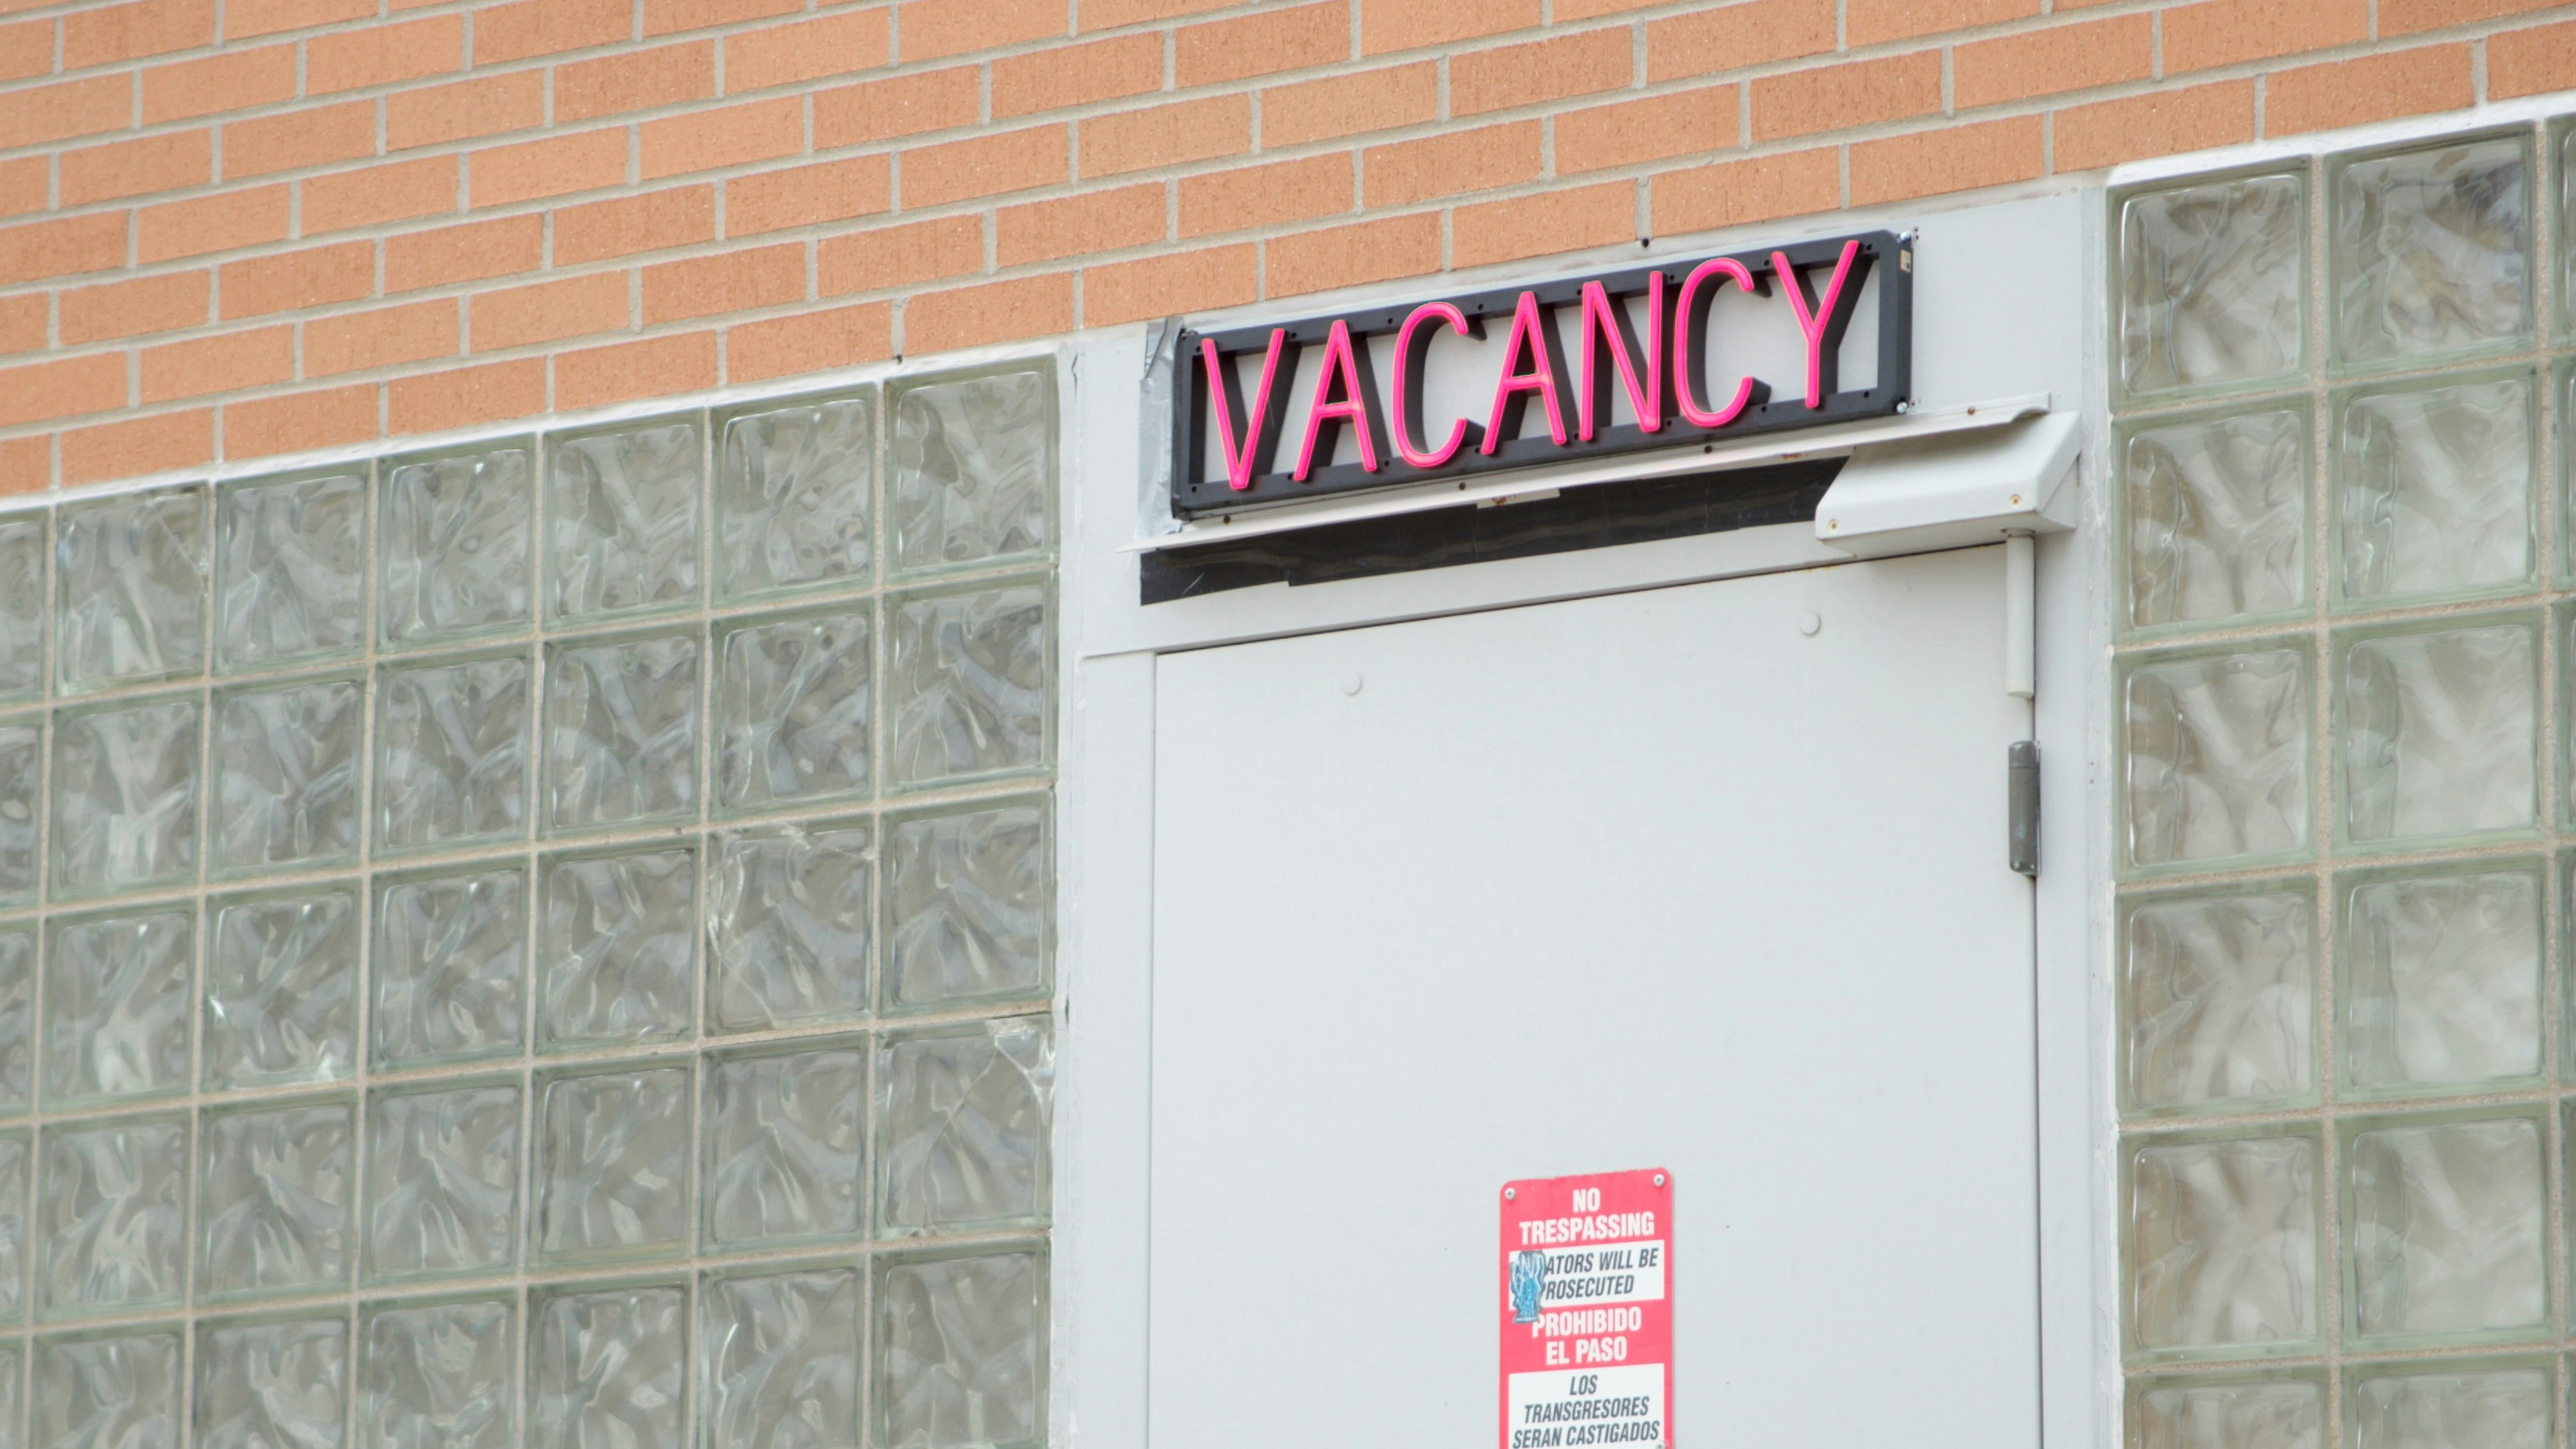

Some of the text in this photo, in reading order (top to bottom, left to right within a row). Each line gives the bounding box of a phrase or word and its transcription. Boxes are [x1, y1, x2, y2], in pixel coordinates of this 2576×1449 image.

[1201, 239, 1860, 491] VACANCY
[1573, 1187, 1601, 1212] NO
[1519, 1212, 1654, 1244] TRESPASSING
[1545, 1247, 1659, 1275] ATORS WILL BE
[1532, 1306, 1642, 1338] PROHIBIDO
[1546, 1336, 1627, 1365] EL PASO
[1570, 1375, 1598, 1395] LOS
[1524, 1395, 1650, 1424] TRANSGRESORES
[1513, 1420, 1660, 1449] SERAN CASTIGADOS
